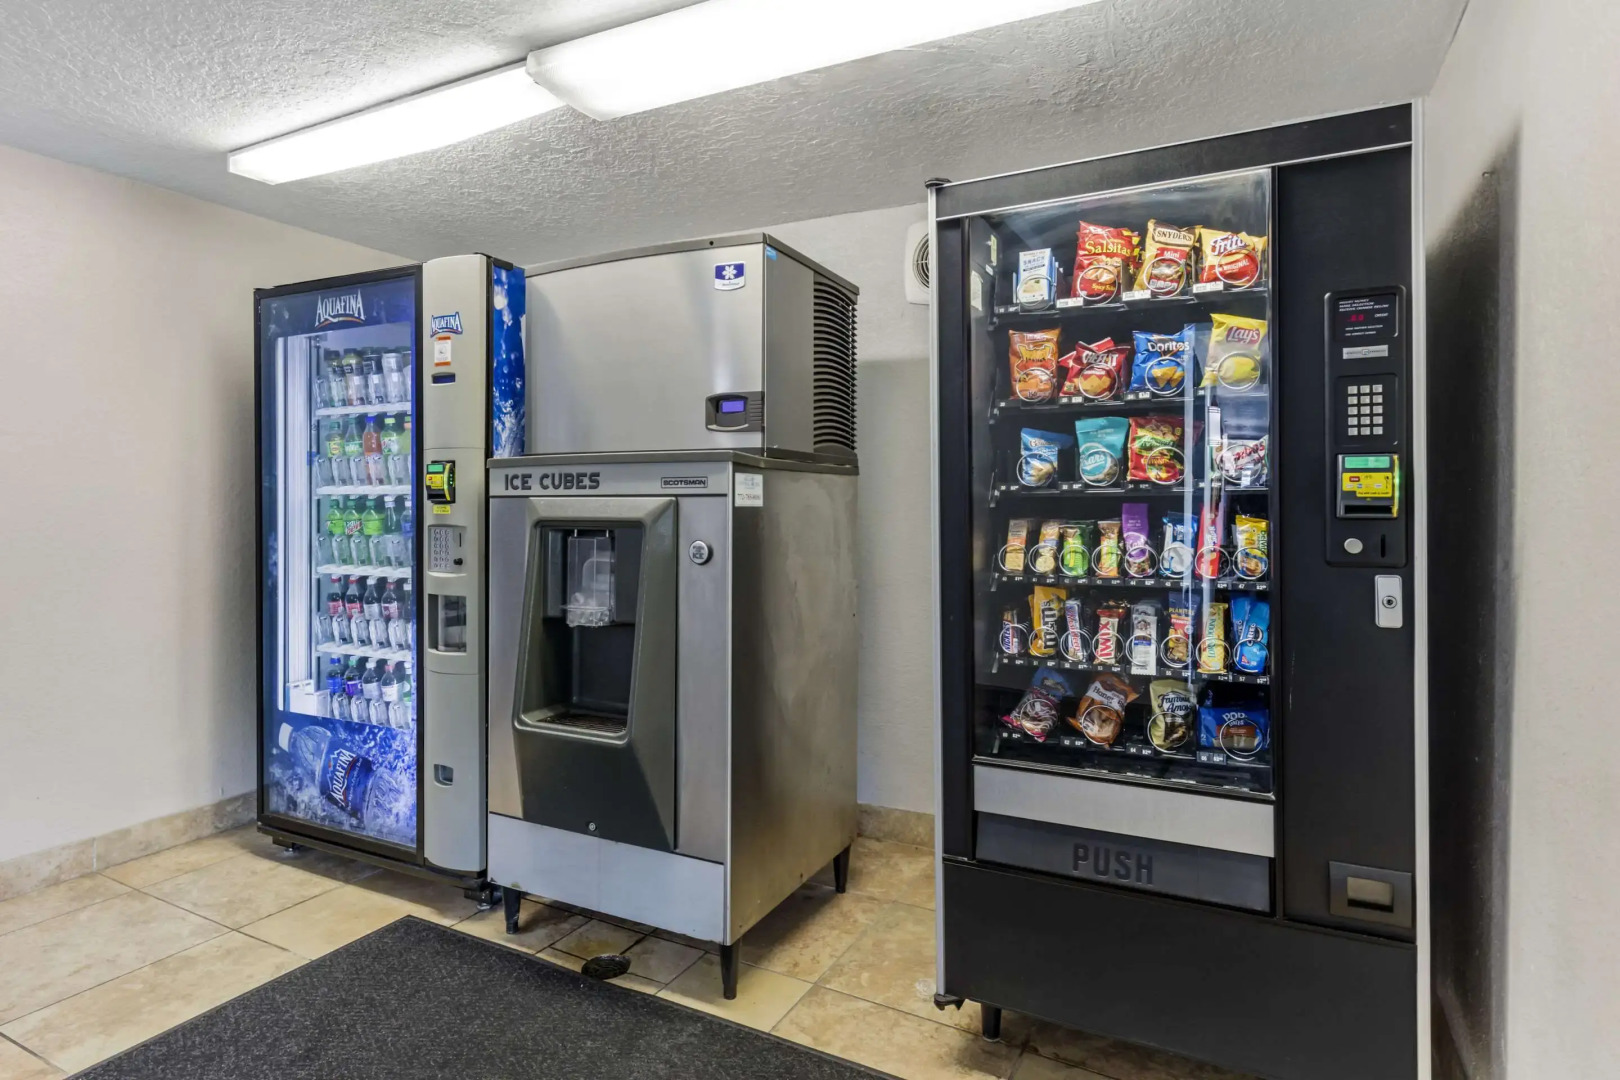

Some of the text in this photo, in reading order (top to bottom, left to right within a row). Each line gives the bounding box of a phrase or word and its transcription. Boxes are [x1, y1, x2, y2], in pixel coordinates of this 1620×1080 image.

[1210, 234, 1249, 255] Frito
[315, 289, 366, 327] AQUAFINA
[431, 312, 463, 336] AQUAFINA
[1227, 327, 1260, 343] Lay's
[1147, 341, 1190, 352] Doritos
[505, 472, 600, 490] ICE CUBES
[663, 479, 706, 487] SCOTSMAN
[1003, 621, 1011, 652] NICKERS
[1098, 621, 1112, 659] TWIX
[330, 749, 357, 807] AQUAFINA
[1073, 842, 1153, 886] PUSH
